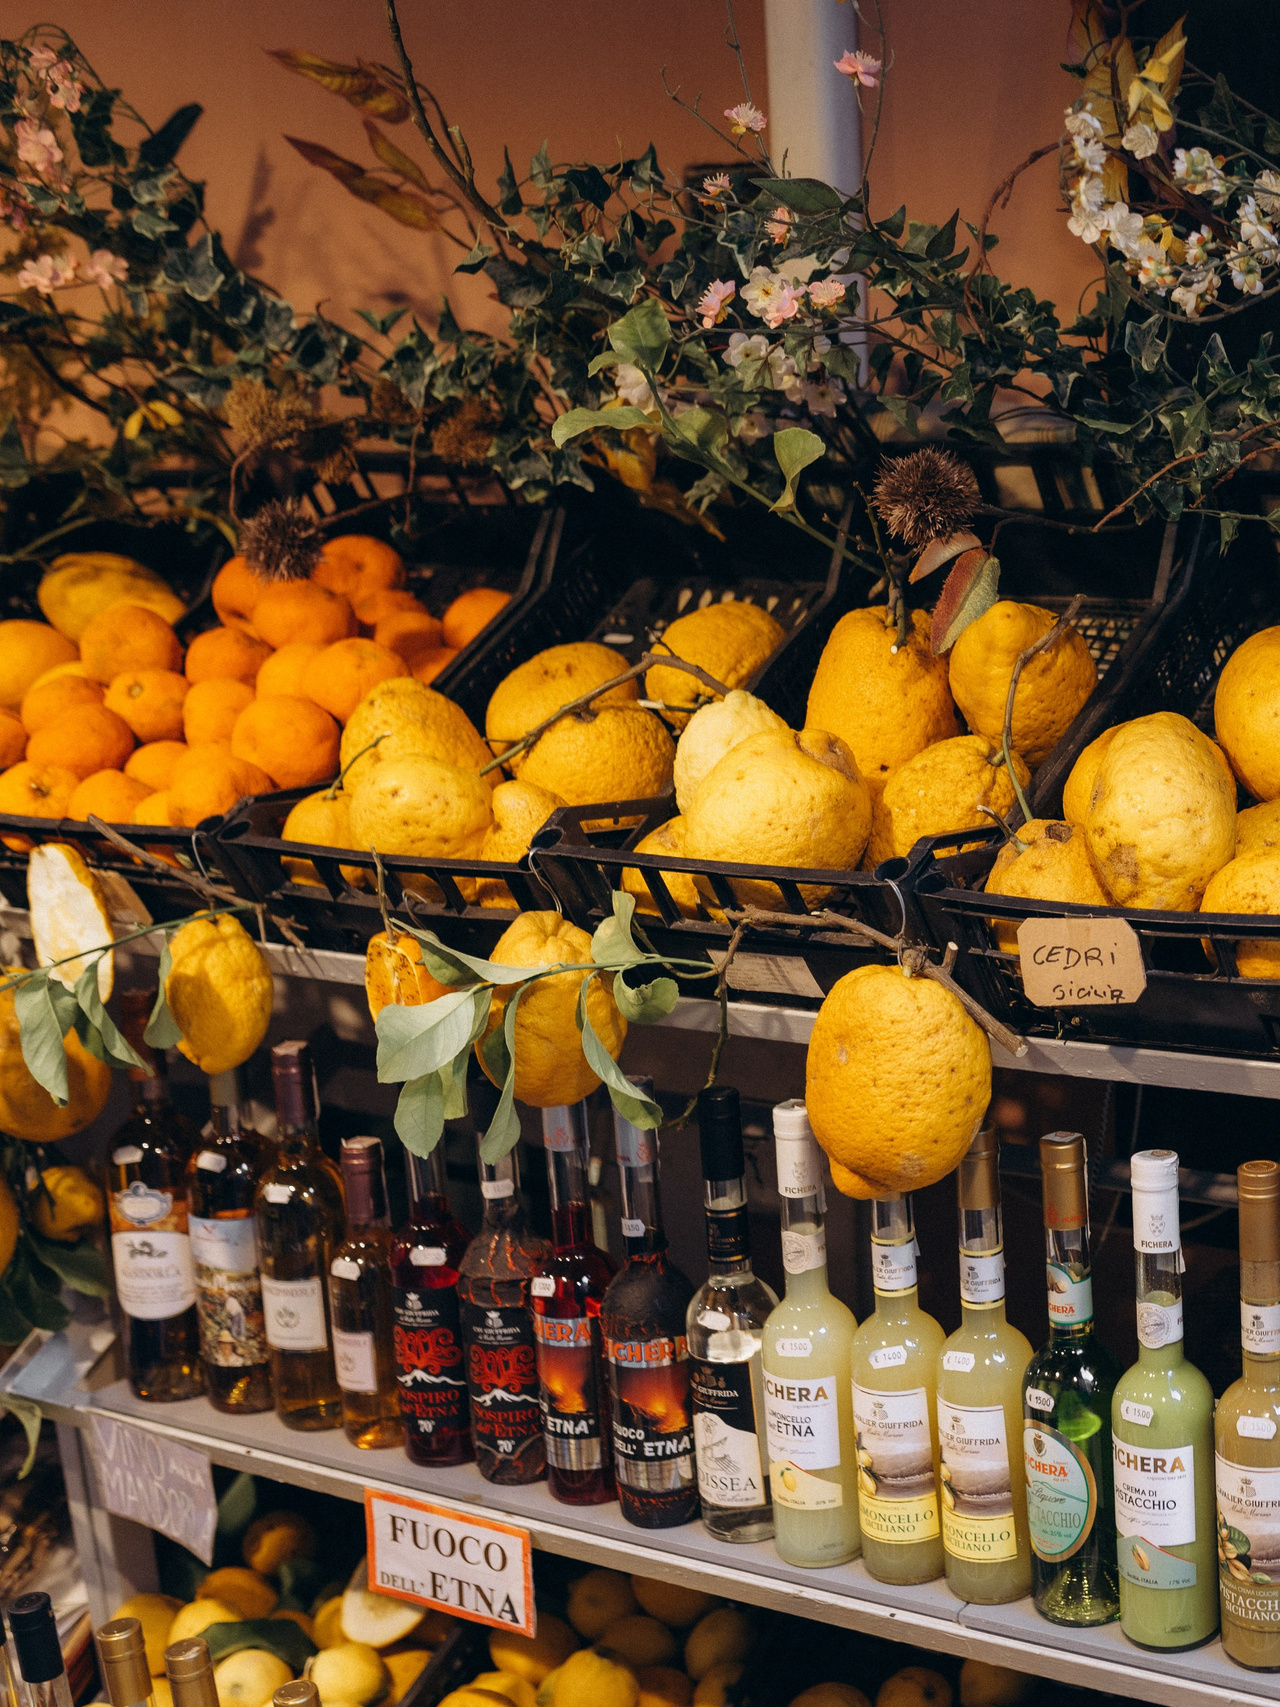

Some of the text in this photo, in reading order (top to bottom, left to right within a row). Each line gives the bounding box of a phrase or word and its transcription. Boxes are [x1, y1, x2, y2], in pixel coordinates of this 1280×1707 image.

[784, 1184, 817, 1194] FICHERA
[1141, 1240, 1173, 1248] FICHERA
[1048, 1302, 1075, 1314] CHERA
[535, 1315, 592, 1342] HERA
[763, 1376, 829, 1402] ICHERA
[777, 1421, 815, 1437] ETNA
[878, 1420, 924, 1429] GIUFFRIDA
[956, 1437, 1001, 1446] GIUFFRIDA
[1123, 1482, 1157, 1498] CREMA DI
[861, 1506, 934, 1524] MONCELLO
[1032, 1505, 1082, 1529] TACCHIO
[865, 1517, 916, 1533] SICILIANO
[944, 1521, 1011, 1542] MONCELLO
[389, 1513, 507, 1572] FUOCO
[380, 1570, 521, 1625] DELL' ETNA
[1226, 1600, 1280, 1622] SICILIANO
